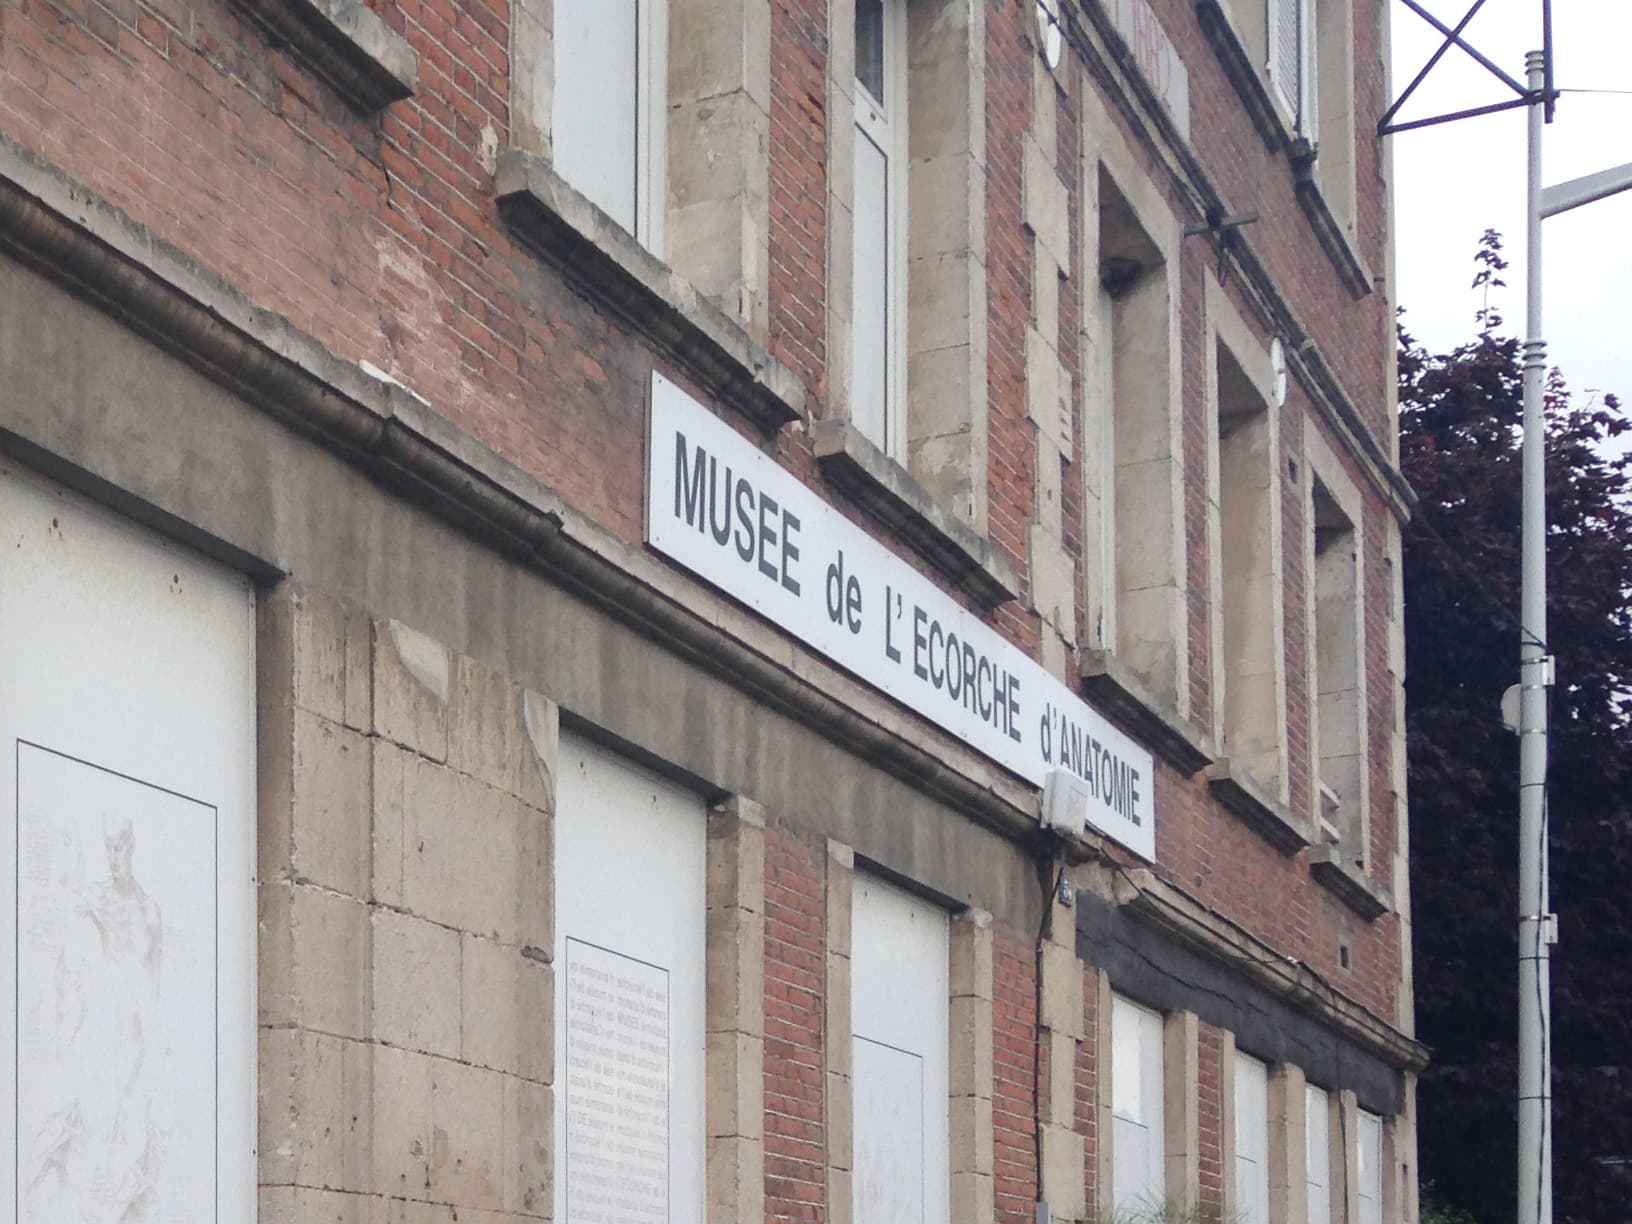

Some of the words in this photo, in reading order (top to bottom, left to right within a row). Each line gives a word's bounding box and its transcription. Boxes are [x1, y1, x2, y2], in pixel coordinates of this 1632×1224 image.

[674, 431, 801, 598] MUSEE
[826, 549, 863, 635] de
[1040, 702, 1142, 828] d'ANATOMIE
